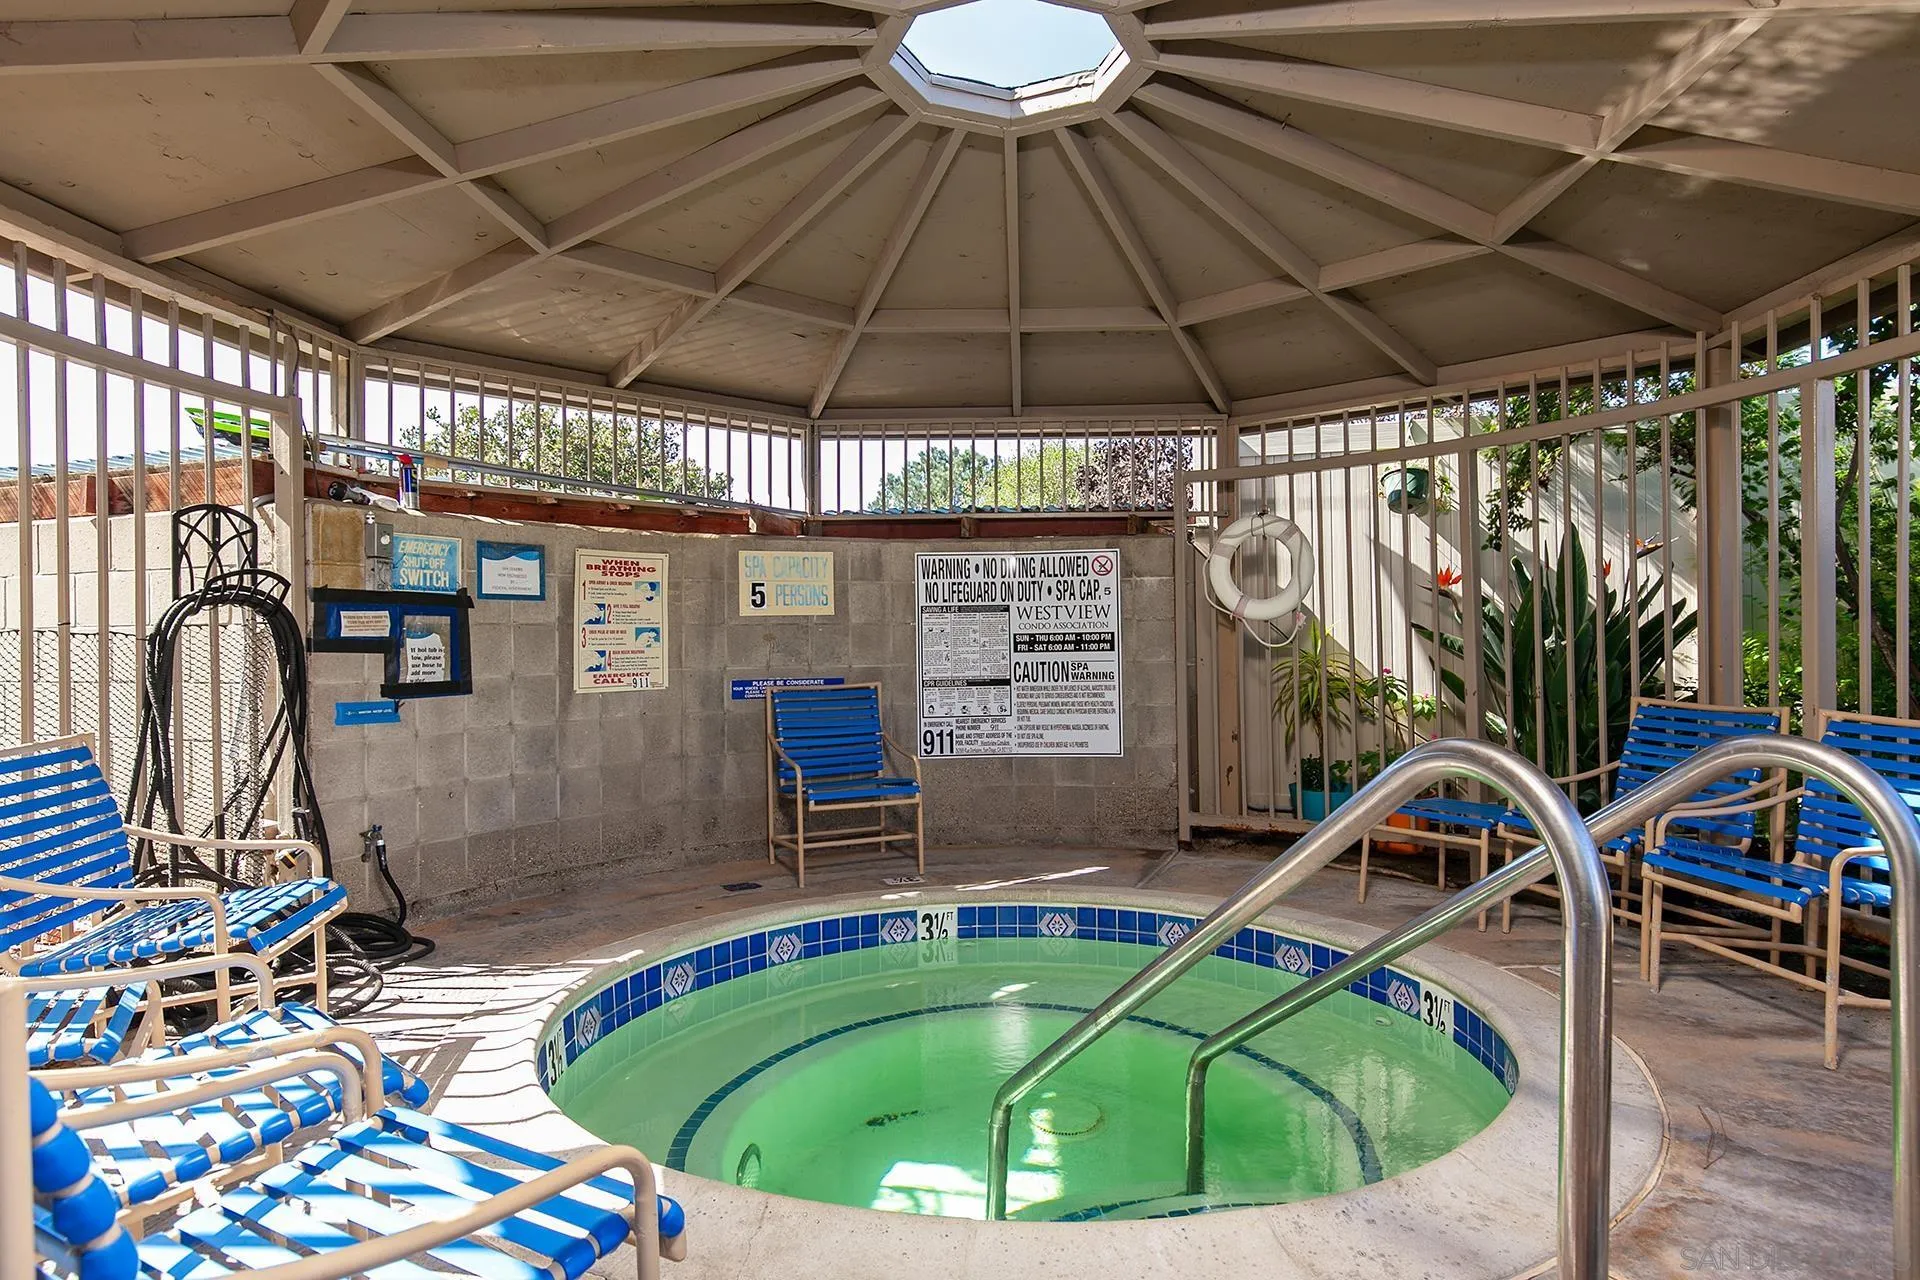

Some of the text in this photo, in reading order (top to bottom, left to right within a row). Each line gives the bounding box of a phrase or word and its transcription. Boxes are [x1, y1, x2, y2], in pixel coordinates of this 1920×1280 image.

[398, 540, 451, 556] EMERGENCY
[403, 556, 446, 569] SHUT-OFF
[586, 564, 656, 573] BREATHING
[744, 555, 828, 578] SPA CAPACITY
[921, 555, 1089, 579] WARNING NO DIVING ALLOWED
[400, 568, 449, 587] SWITCH
[751, 582, 829, 608] 5 PERSONS
[925, 579, 1112, 603] NO LIFEGUARD ON DUTY SPA CAP. 5
[607, 604, 611, 624] 2
[1016, 604, 1111, 620] WESTVIEW
[1018, 621, 1109, 630] CONDO ASSOCIATION
[582, 627, 586, 648] 3
[1014, 661, 1069, 683] CAUTION
[1071, 663, 1088, 671] SPA
[632, 678, 649, 688] 911
[1071, 672, 1115, 680] WARNING
[923, 729, 954, 754] 911
[947, 912, 953, 920] FT
